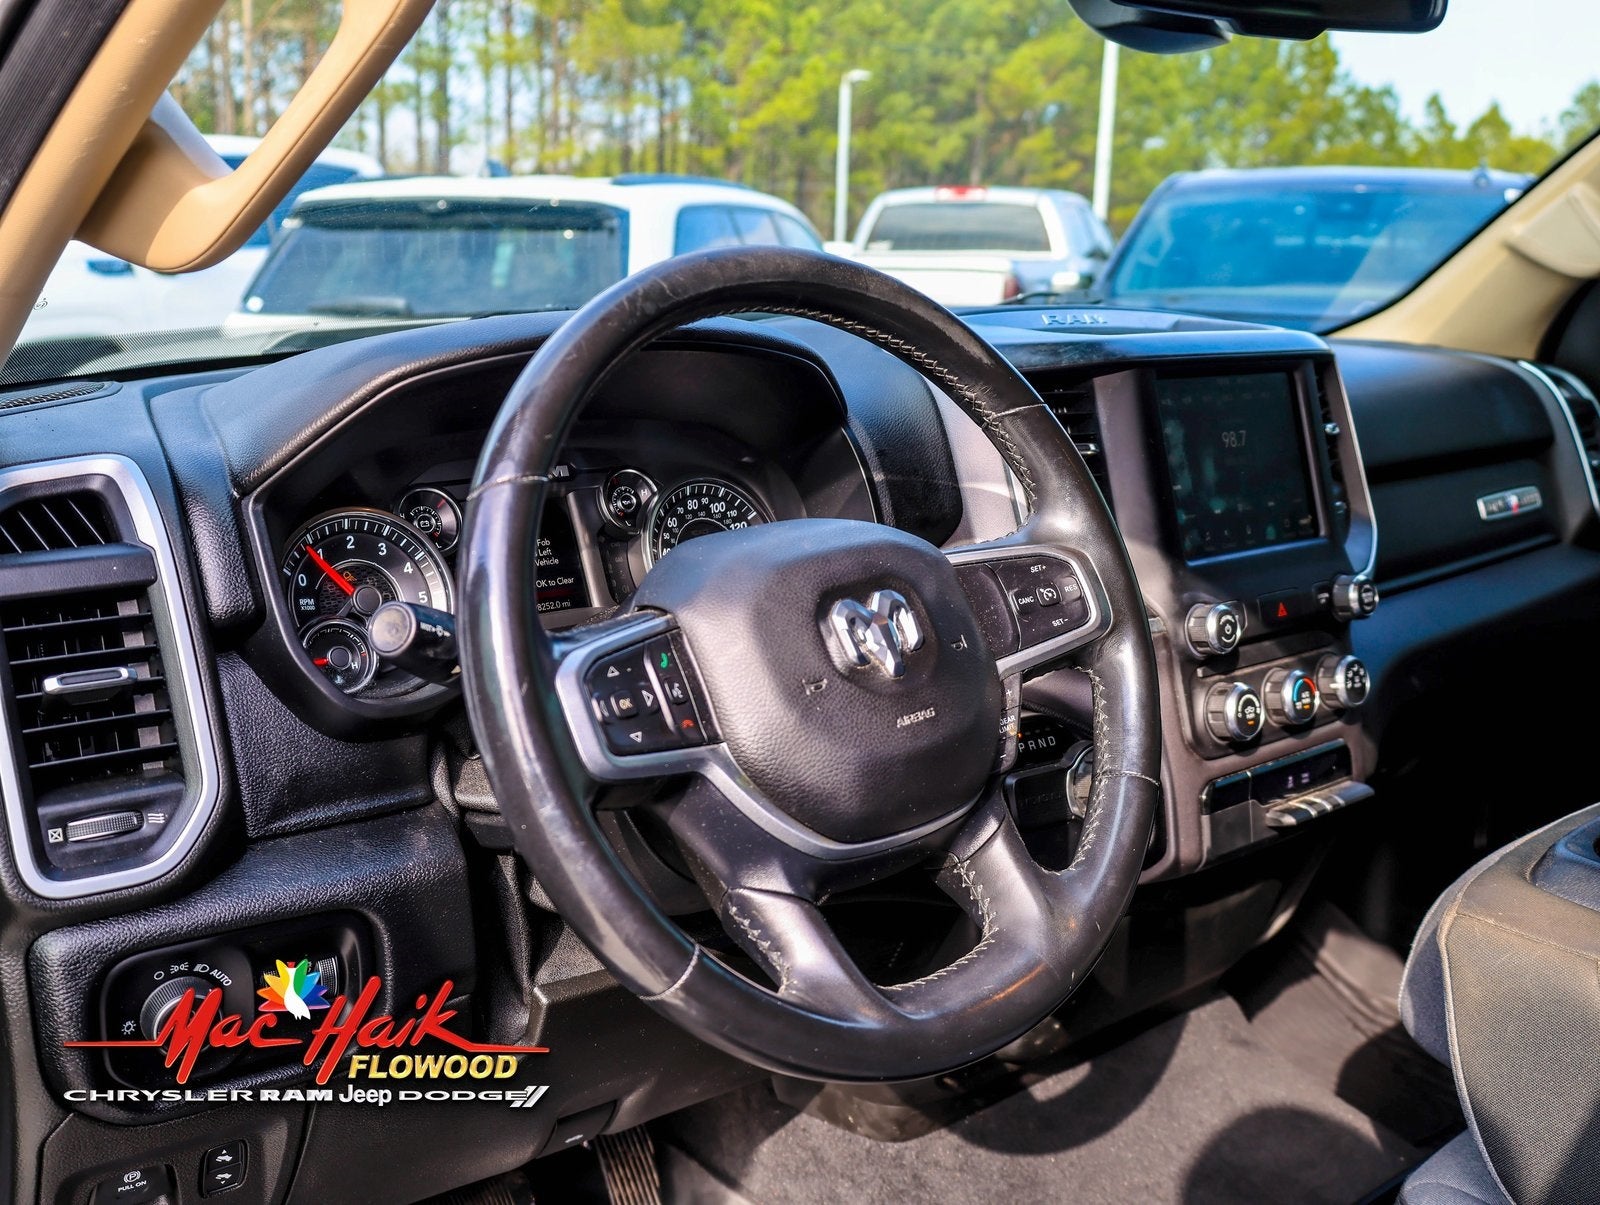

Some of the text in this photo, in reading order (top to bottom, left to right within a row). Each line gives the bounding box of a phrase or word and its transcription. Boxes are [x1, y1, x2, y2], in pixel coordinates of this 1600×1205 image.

[1041, 313, 1108, 326] RAM
[1221, 430, 1247, 448] 98.7
[687, 499, 699, 510] 80
[700, 497, 709, 505] 90
[676, 506, 684, 515] 70
[709, 501, 726, 514] 100
[726, 509, 738, 518] 110
[667, 517, 678, 528] 60
[663, 532, 670, 540] 50
[346, 535, 355, 549] 2
[536, 538, 551, 547] Fob
[378, 542, 387, 556] 3
[535, 557, 559, 566] Vehicle
[403, 562, 413, 574] 4
[298, 573, 307, 587] 0
[535, 579, 548, 588] OK
[556, 577, 575, 585] Clear
[1064, 583, 1078, 593] RES
[299, 598, 315, 606] RPM
[418, 590, 428, 604] 5
[1018, 595, 1035, 605] CANC
[351, 661, 358, 670] H
[619, 697, 634, 710] OK
[896, 707, 935, 728] AIRBAG
[209, 967, 233, 987] AUTO
[117, 1179, 147, 1193] PULL ON
